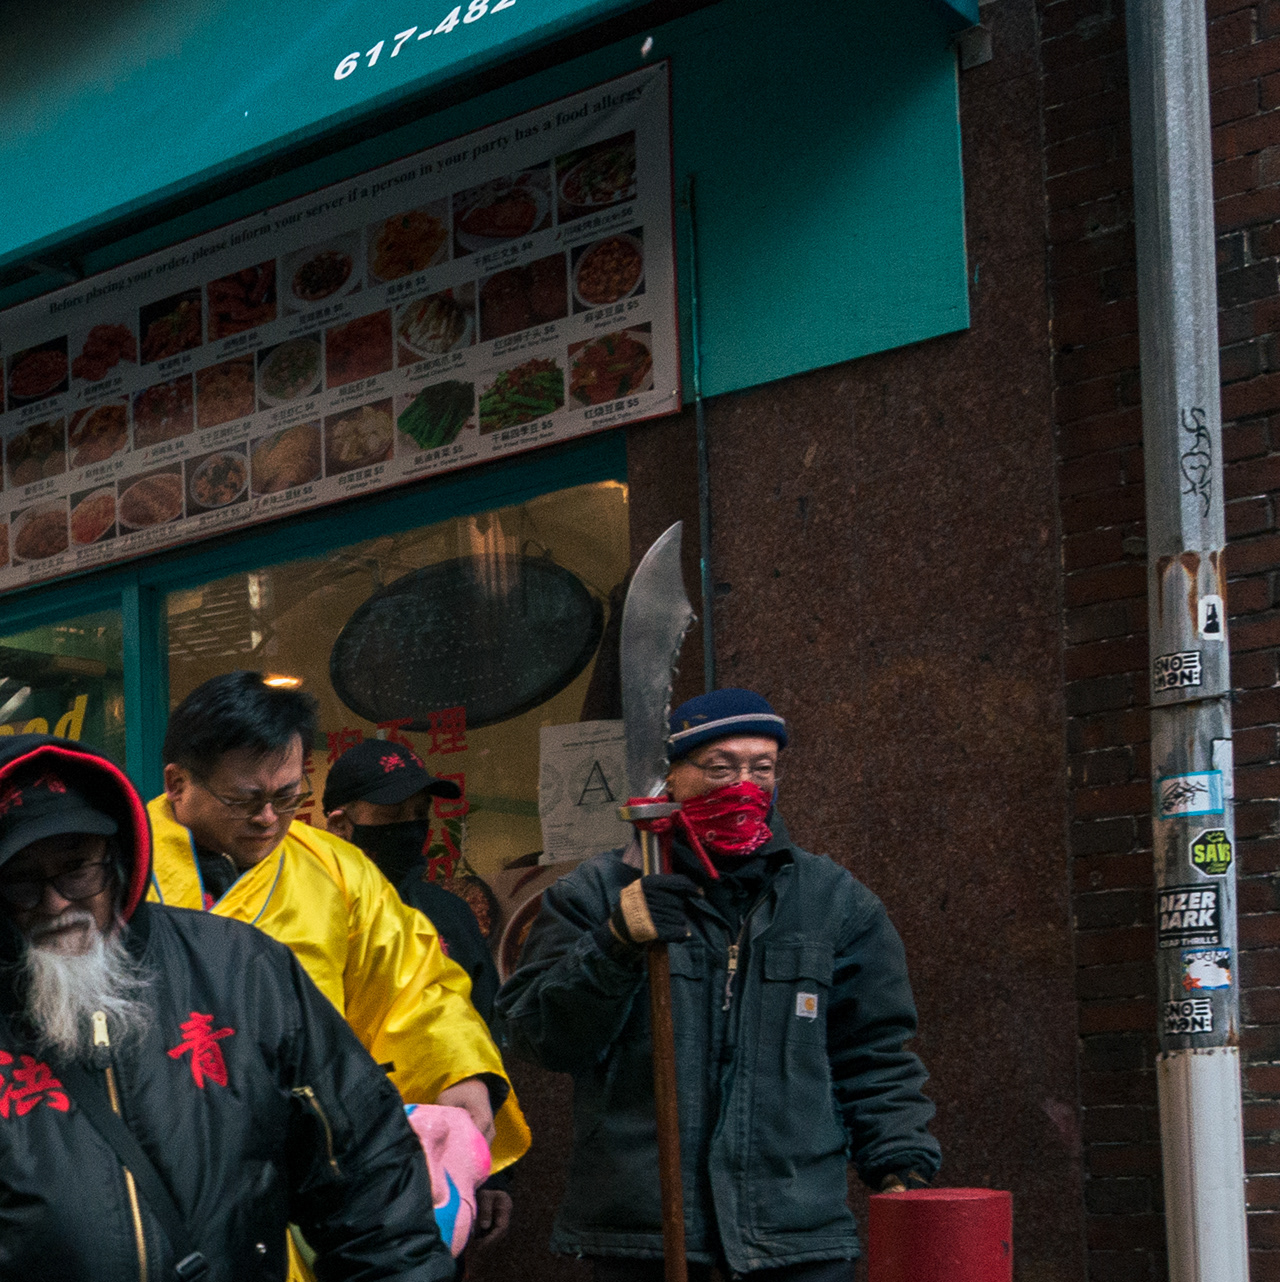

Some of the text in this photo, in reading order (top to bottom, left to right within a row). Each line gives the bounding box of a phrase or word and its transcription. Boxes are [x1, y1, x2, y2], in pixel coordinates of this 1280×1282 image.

[49, 296, 84, 315] Before
[86, 278, 125, 304] placing
[128, 268, 154, 288] your
[191, 241, 228, 264] please
[230, 223, 272, 247] inform
[274, 210, 303, 234] your
[305, 196, 344, 218] server
[347, 186, 359, 203] if
[360, 187, 369, 199] a
[371, 171, 416, 199] person
[420, 162, 433, 177] in
[436, 152, 469, 174] your
[471, 134, 510, 161] party
[515, 124, 539, 142] has
[542, 121, 551, 132] a
[555, 103, 589, 128] food
[592, 86, 644, 114] allergy
[584, 300, 640, 324] 麻婆豆腐 $5
[544, 324, 556, 336] $6
[584, 397, 640, 420] 红烧豆腐 $5
[541, 420, 554, 431] $5
[452, 444, 464, 455] $5
[574, 759, 617, 807] A
[167, 1011, 236, 1090] 青
